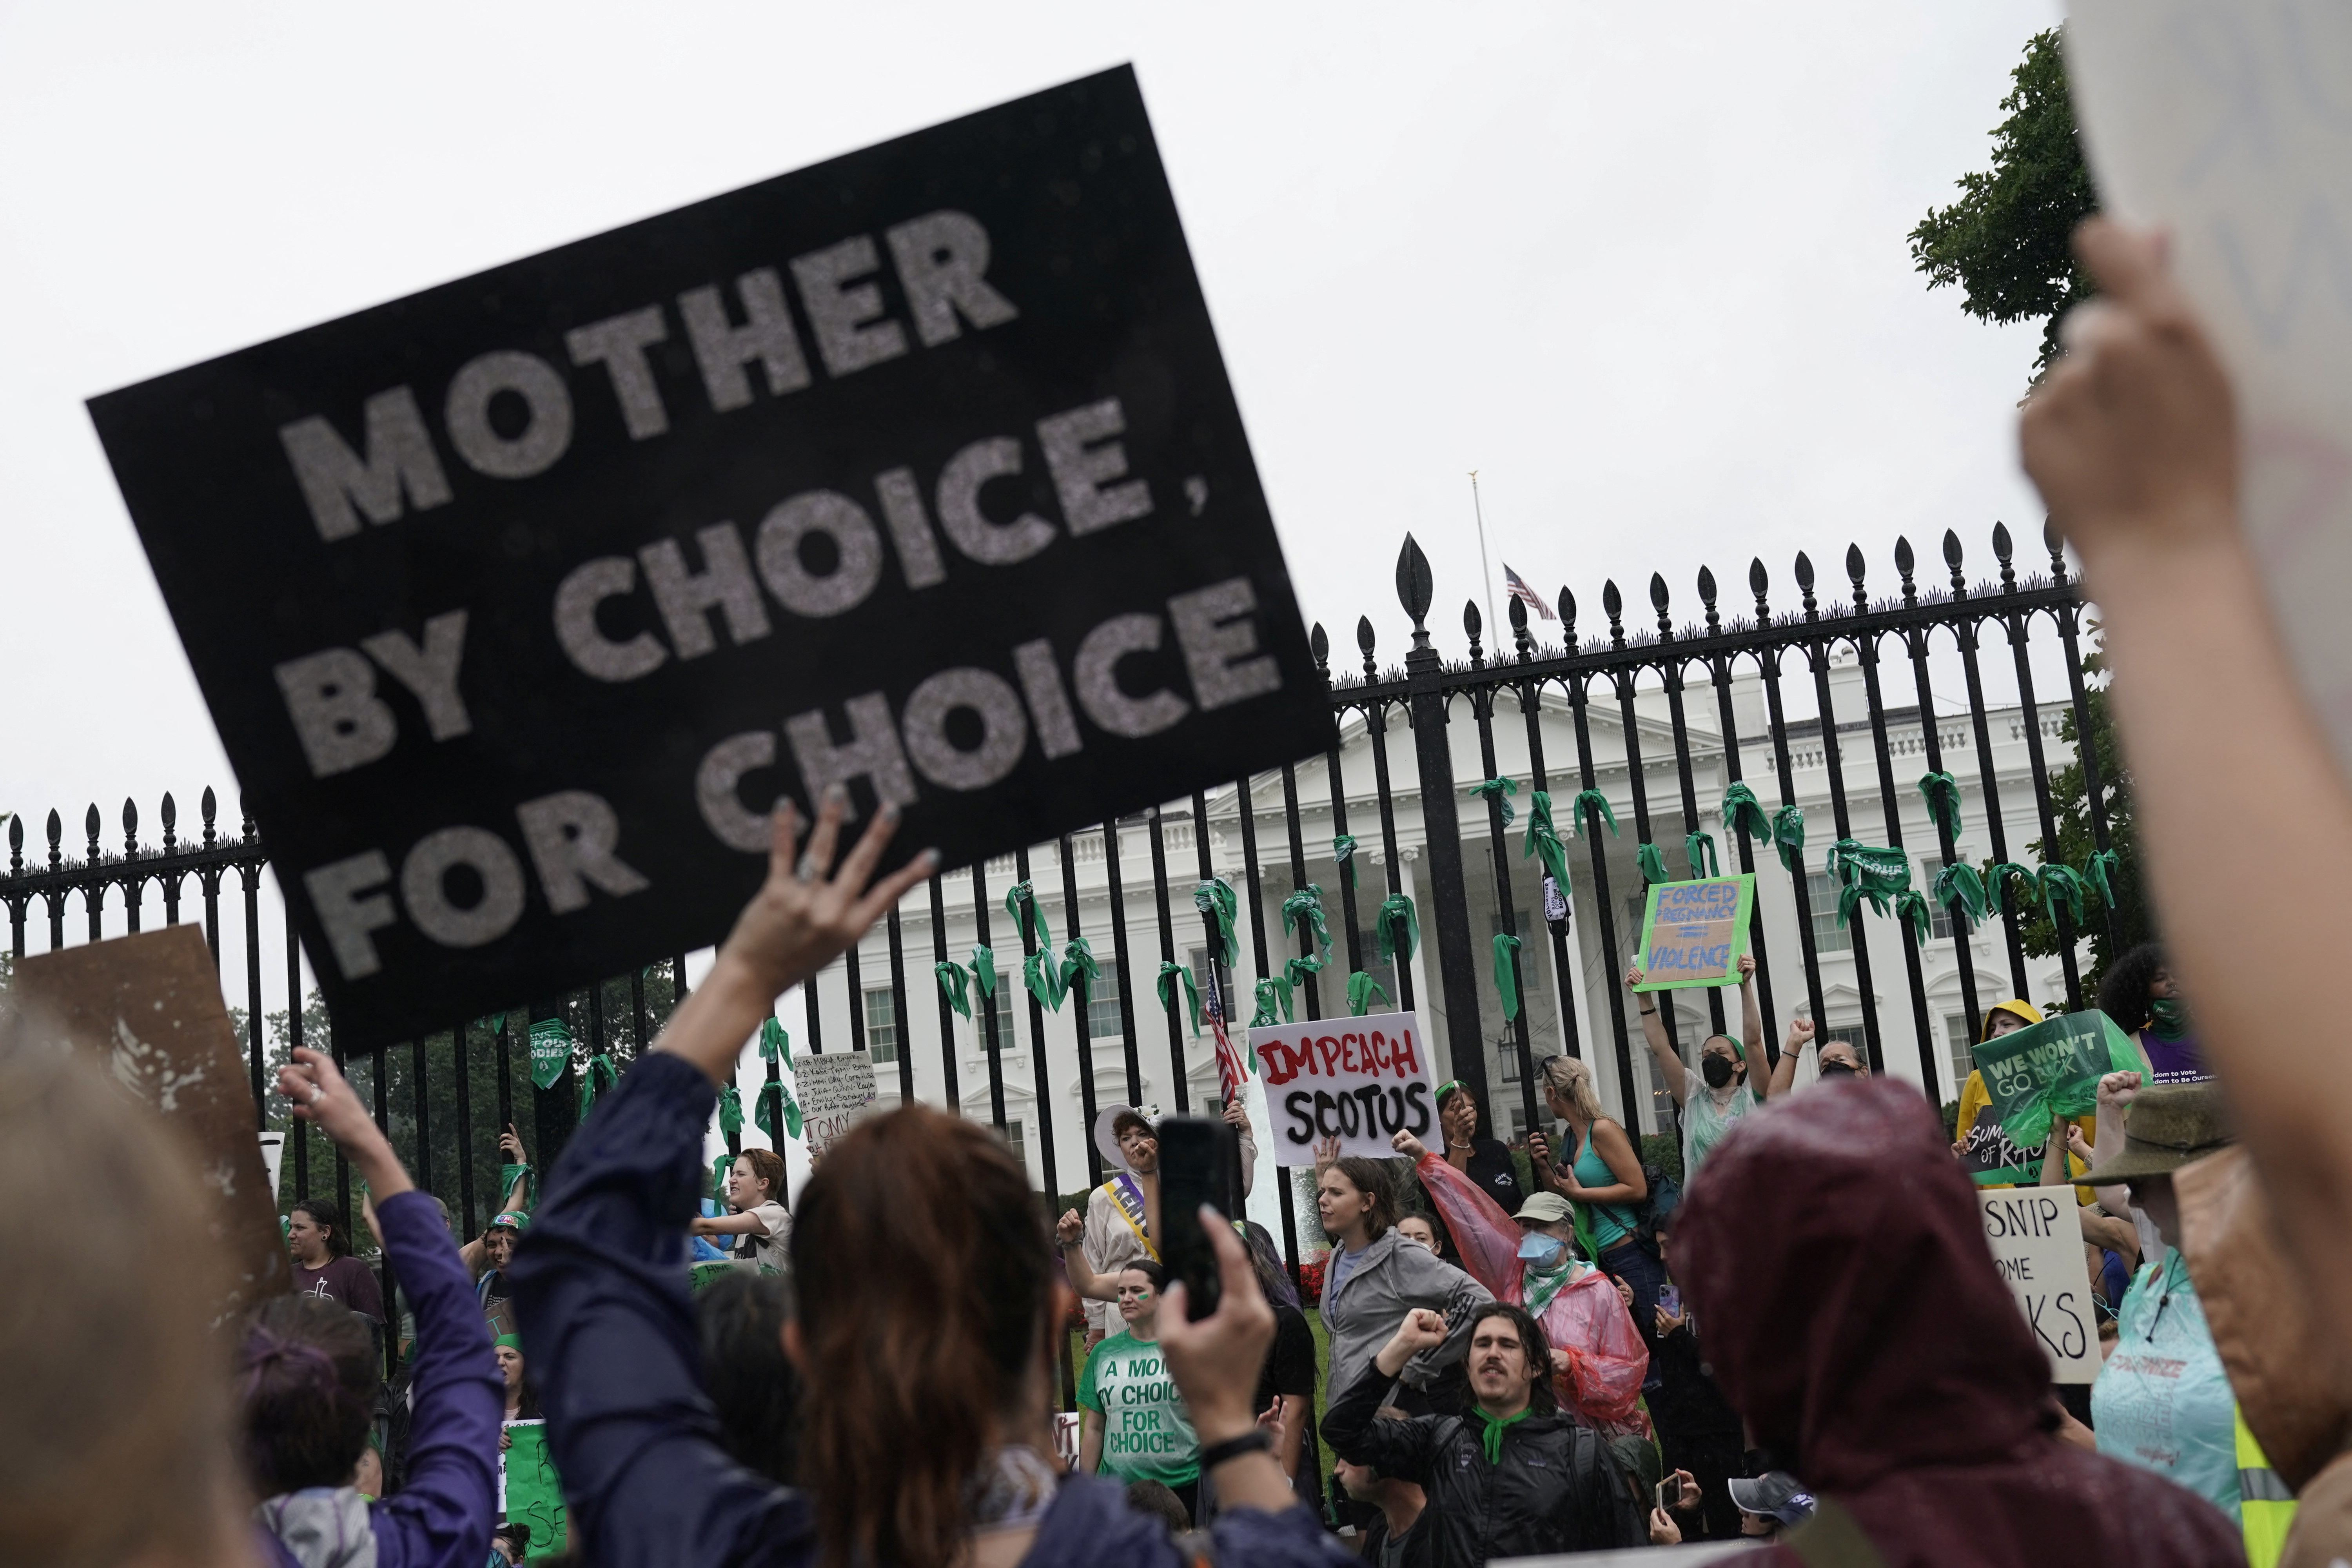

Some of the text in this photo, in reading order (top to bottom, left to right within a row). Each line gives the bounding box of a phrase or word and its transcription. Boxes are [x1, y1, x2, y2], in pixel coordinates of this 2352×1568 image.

[276, 208, 1020, 543] MOTHER
[272, 397, 1211, 779] BY CHOICE,
[302, 575, 1283, 980] FOR CHOICE
[1871, 863, 1903, 873] OUR
[1657, 884, 1736, 906] FORCED
[1655, 904, 1737, 924] PREGNANCY
[1647, 944, 1730, 971] VIOLENCE
[1257, 1030, 1418, 1085] IMPEACH
[1987, 1032, 2096, 1080] WE WON'T
[1997, 1073, 2031, 1097] GO
[818, 1111, 849, 1139] ONLY
[1285, 1082, 1430, 1144] SCOTUS
[1980, 1144, 1996, 1164] OF
[1985, 1198, 2058, 1238] SNIP
[1105, 1361, 1118, 1377] A
[1122, 1381, 1183, 1405] CHOIC
[1122, 1410, 1161, 1432] FOR
[1111, 1431, 1175, 1454] CHOICE
